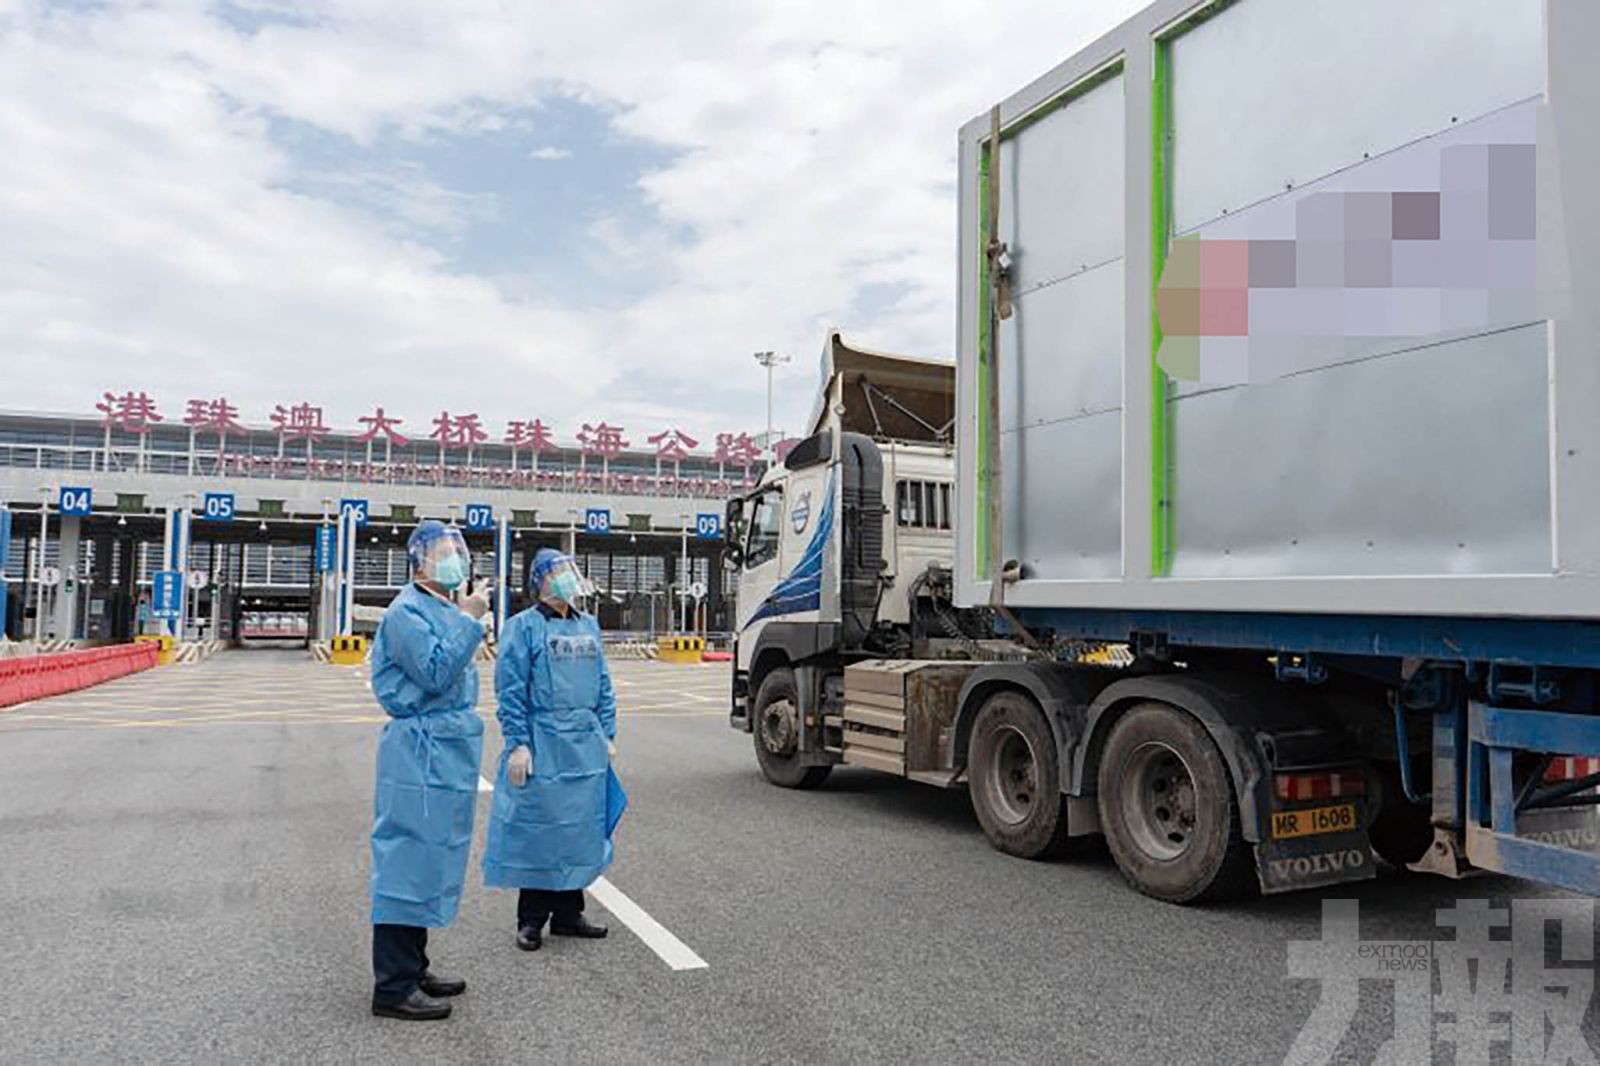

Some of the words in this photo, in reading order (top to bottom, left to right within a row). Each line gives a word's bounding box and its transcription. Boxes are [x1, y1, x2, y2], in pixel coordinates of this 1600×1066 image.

[63, 492, 87, 510] 04
[207, 497, 231, 515] 05
[343, 503, 365, 521] 06
[468, 508, 490, 524] 07
[588, 513, 608, 530] 08
[699, 517, 717, 534] 09
[1312, 806, 1351, 832] 1608
[1270, 849, 1363, 879] VOLVO
